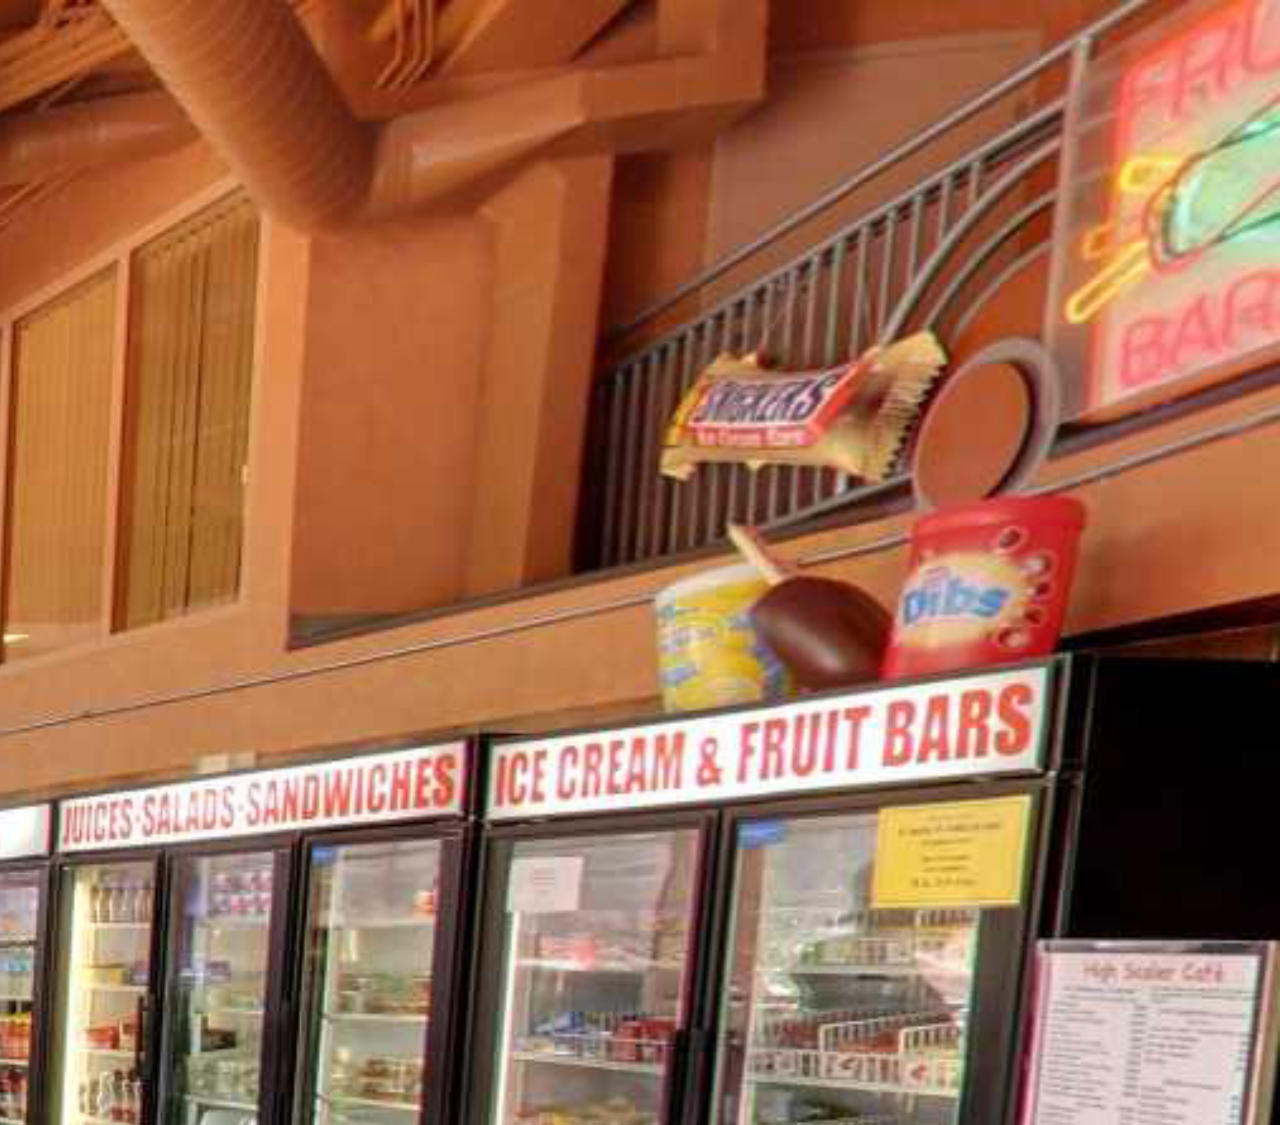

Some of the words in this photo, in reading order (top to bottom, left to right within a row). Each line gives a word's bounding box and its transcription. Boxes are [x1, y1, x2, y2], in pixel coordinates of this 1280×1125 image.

[694, 372, 838, 422] SNICKERS
[493, 750, 548, 806] ICE
[555, 731, 686, 800] CREAM
[696, 737, 723, 787] &
[736, 705, 874, 783] FRUIT
[882, 682, 1034, 767] BARS
[62, 800, 133, 846] JUICES
[141, 784, 236, 837] SALADS
[244, 752, 458, 828] SANDWICHES
